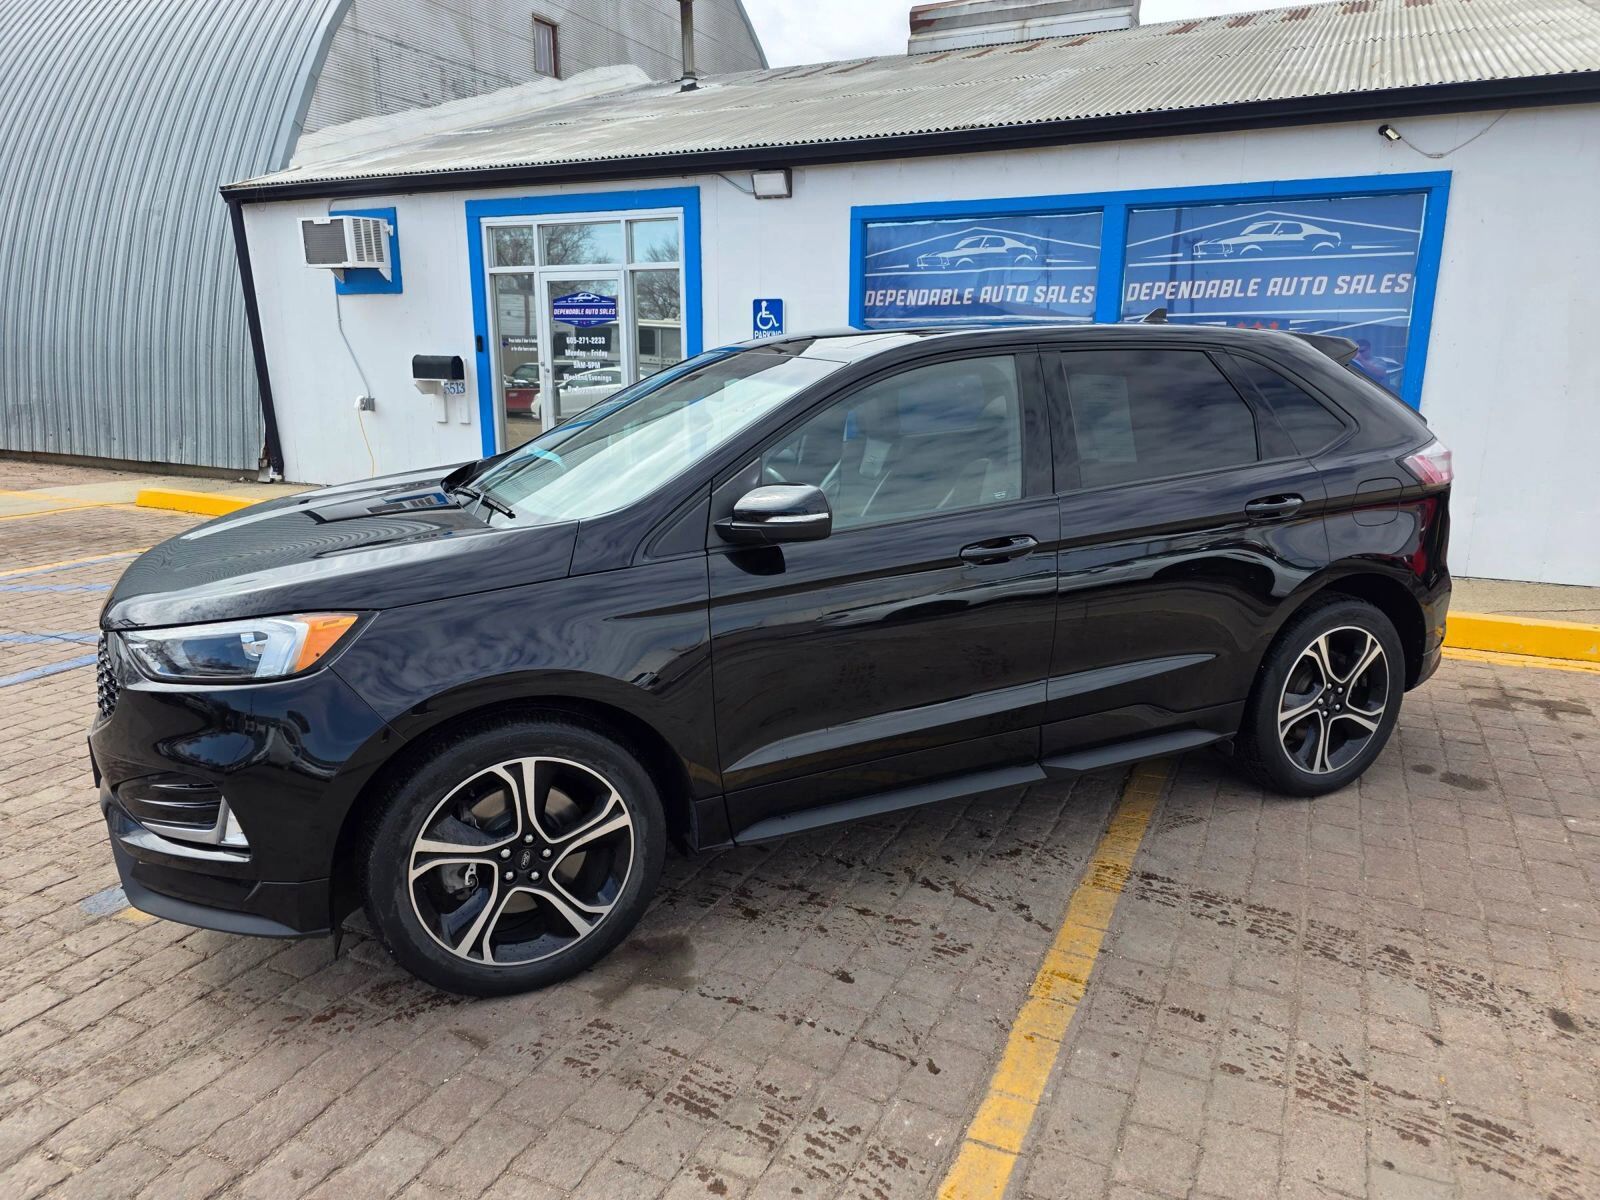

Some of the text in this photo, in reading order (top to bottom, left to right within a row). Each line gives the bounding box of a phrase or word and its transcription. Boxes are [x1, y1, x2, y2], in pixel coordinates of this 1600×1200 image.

[1126, 272, 1412, 301] DEPENDABLE AUTO SALES
[864, 285, 1095, 306] DEPENDABLE AUTO SALES
[591, 349, 608, 358] Friday
[444, 382, 466, 395] 5513
